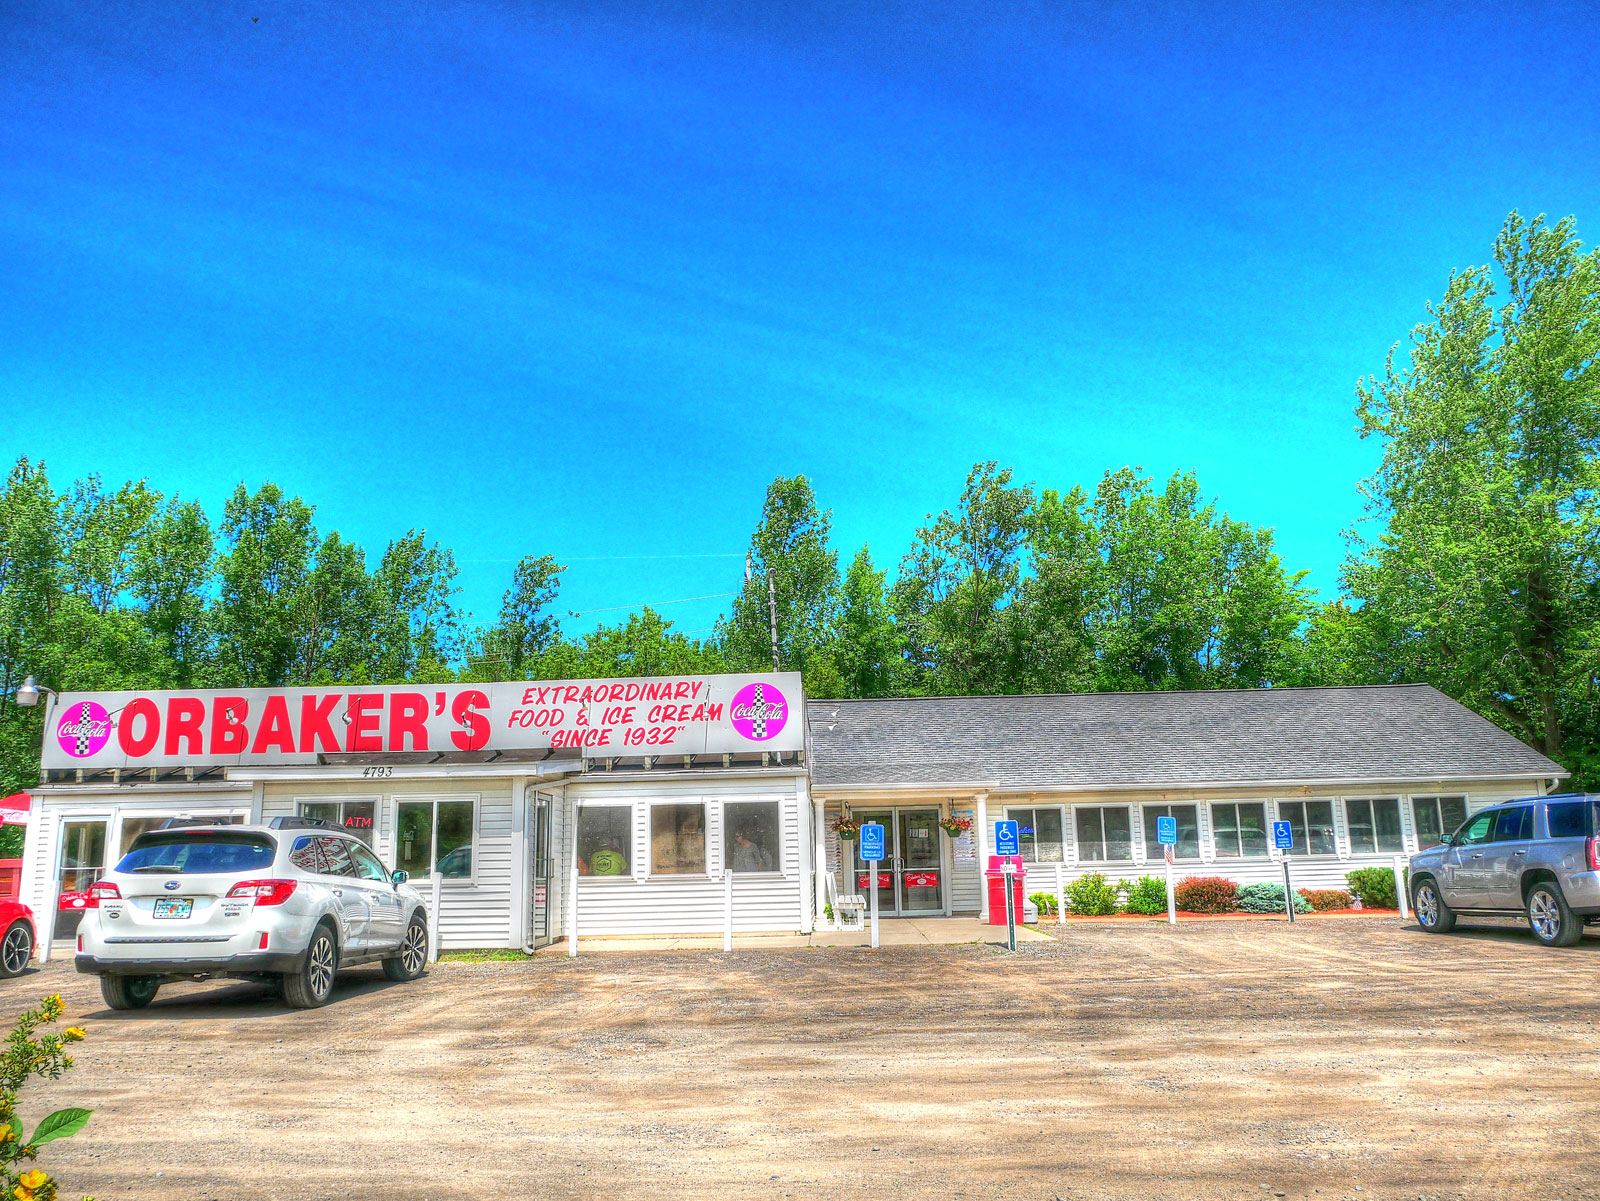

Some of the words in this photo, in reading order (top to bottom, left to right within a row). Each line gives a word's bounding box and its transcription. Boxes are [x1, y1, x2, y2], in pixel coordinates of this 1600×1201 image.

[521, 681, 703, 706] EXTRAORDINARY
[117, 689, 492, 758] ORBAKER'S
[508, 709, 565, 729] FOOD
[576, 710, 590, 727] &
[601, 706, 637, 726] ICE
[649, 703, 723, 723] CREAM
[363, 766, 393, 778] 4793
[345, 816, 373, 828] ATM
